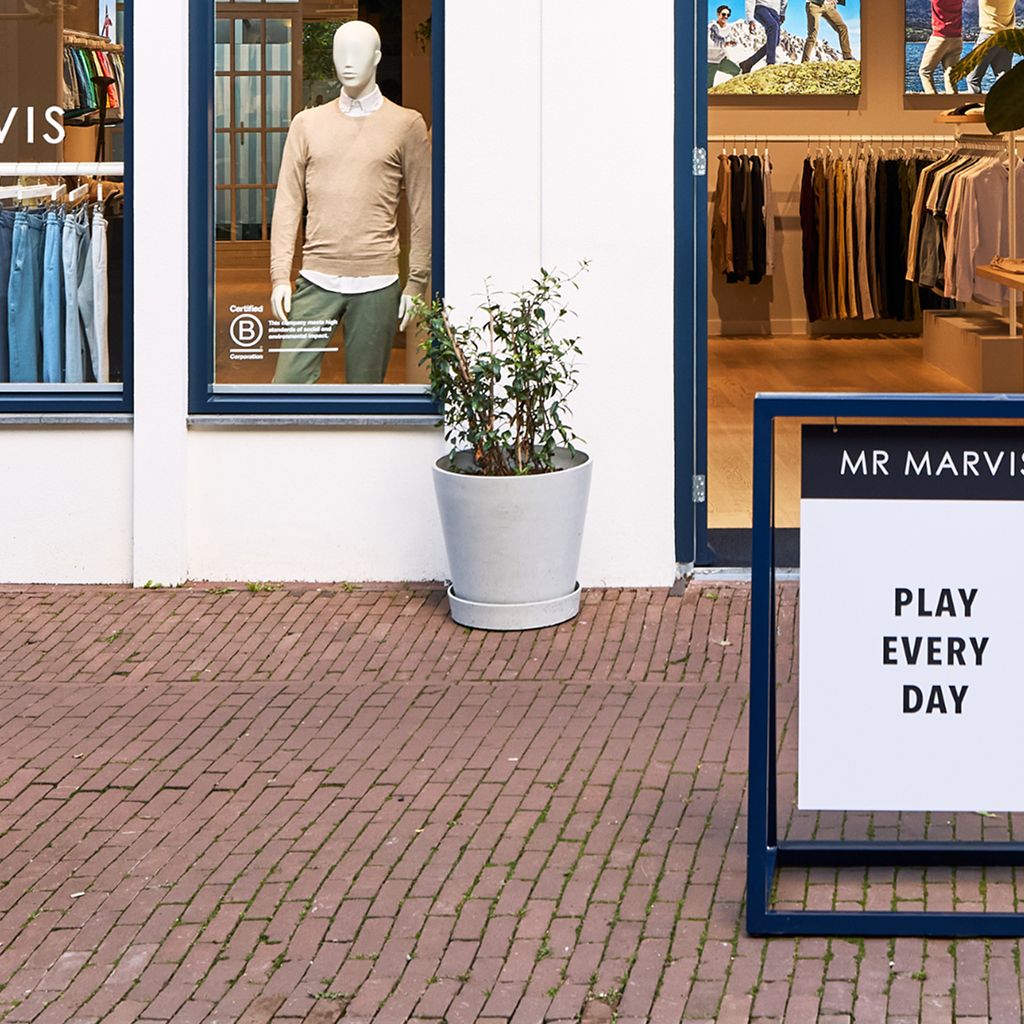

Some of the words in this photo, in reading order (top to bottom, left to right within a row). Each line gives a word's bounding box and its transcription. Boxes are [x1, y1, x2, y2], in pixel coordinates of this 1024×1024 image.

[229, 304, 264, 313] Certified
[840, 449, 890, 476] MR
[894, 588, 978, 617] PLAY
[882, 636, 990, 666] EVERY
[902, 684, 969, 714] DAY
